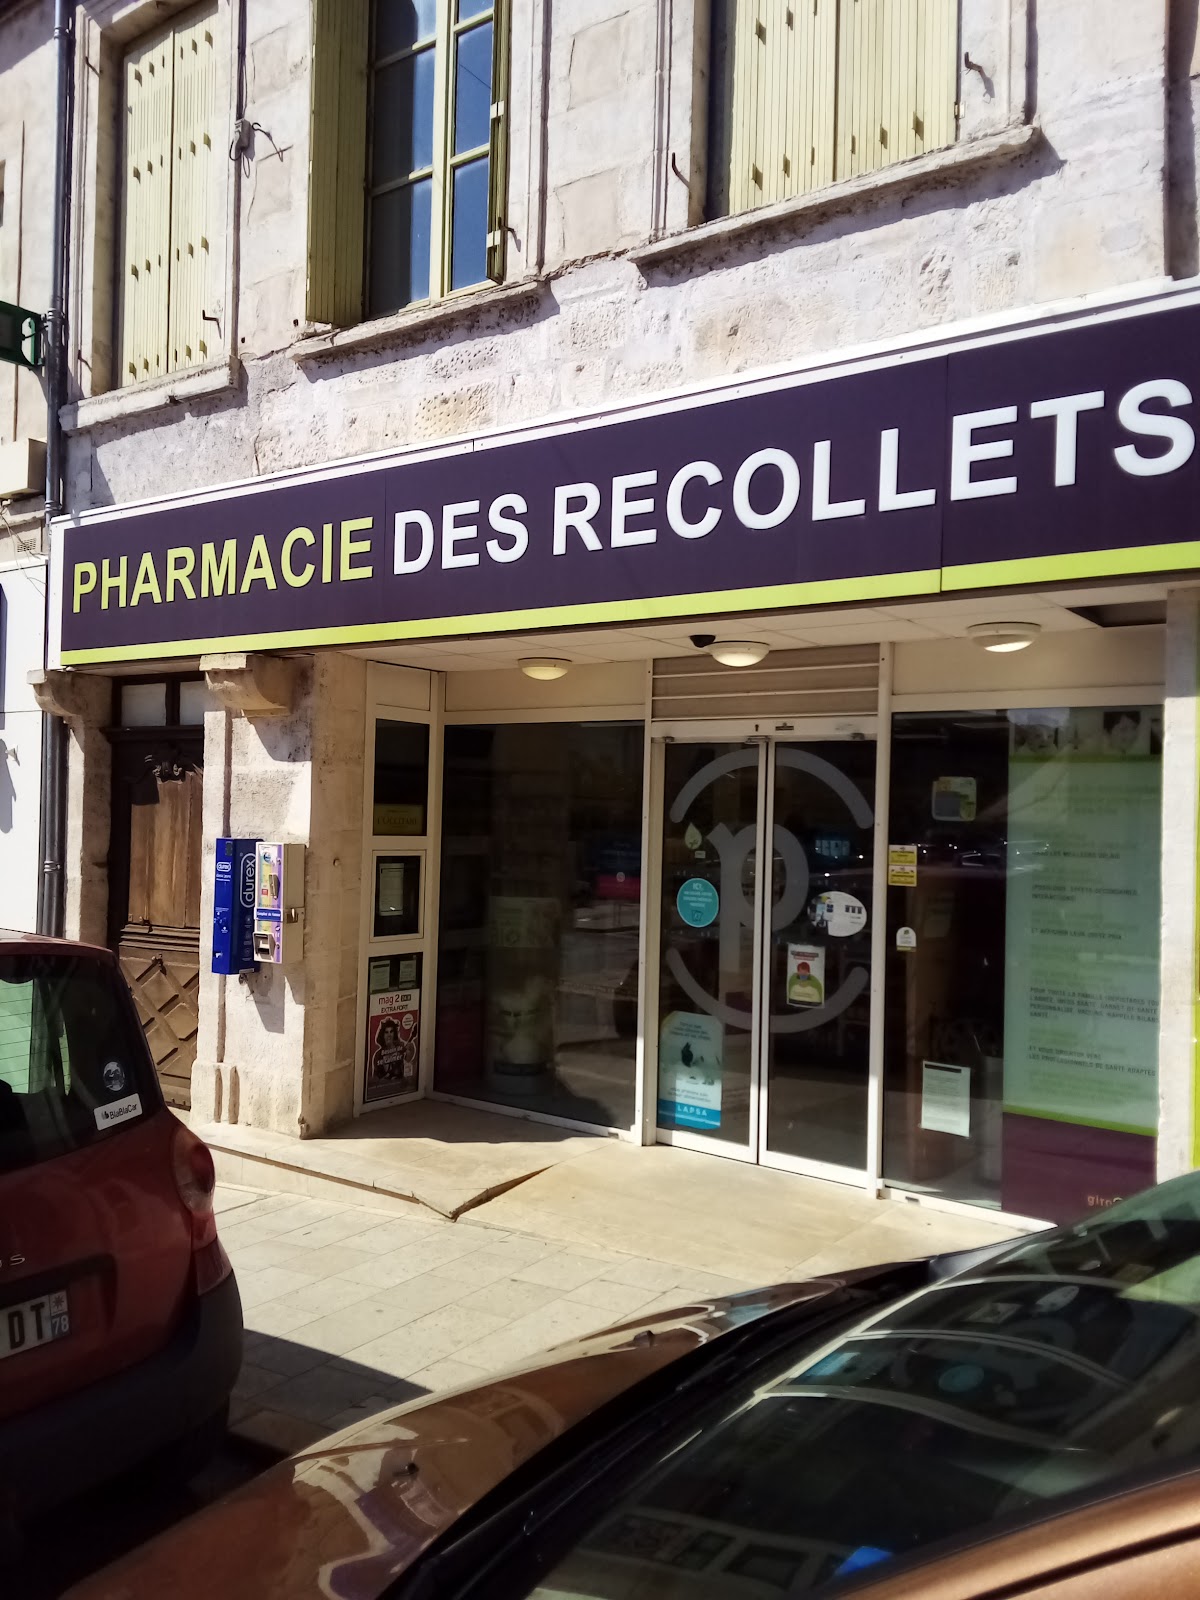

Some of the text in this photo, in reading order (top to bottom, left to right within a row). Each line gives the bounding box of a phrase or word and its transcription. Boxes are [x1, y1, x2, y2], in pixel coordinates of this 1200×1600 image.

[73, 378, 1196, 613] PHARMACIE DES RECOLLETS
[243, 858, 256, 902] durex
[378, 996, 394, 1006] mag
[395, 994, 400, 1003] 2
[109, 1103, 137, 1120] BlaBlaCar
[52, 1315, 70, 1335] 78
